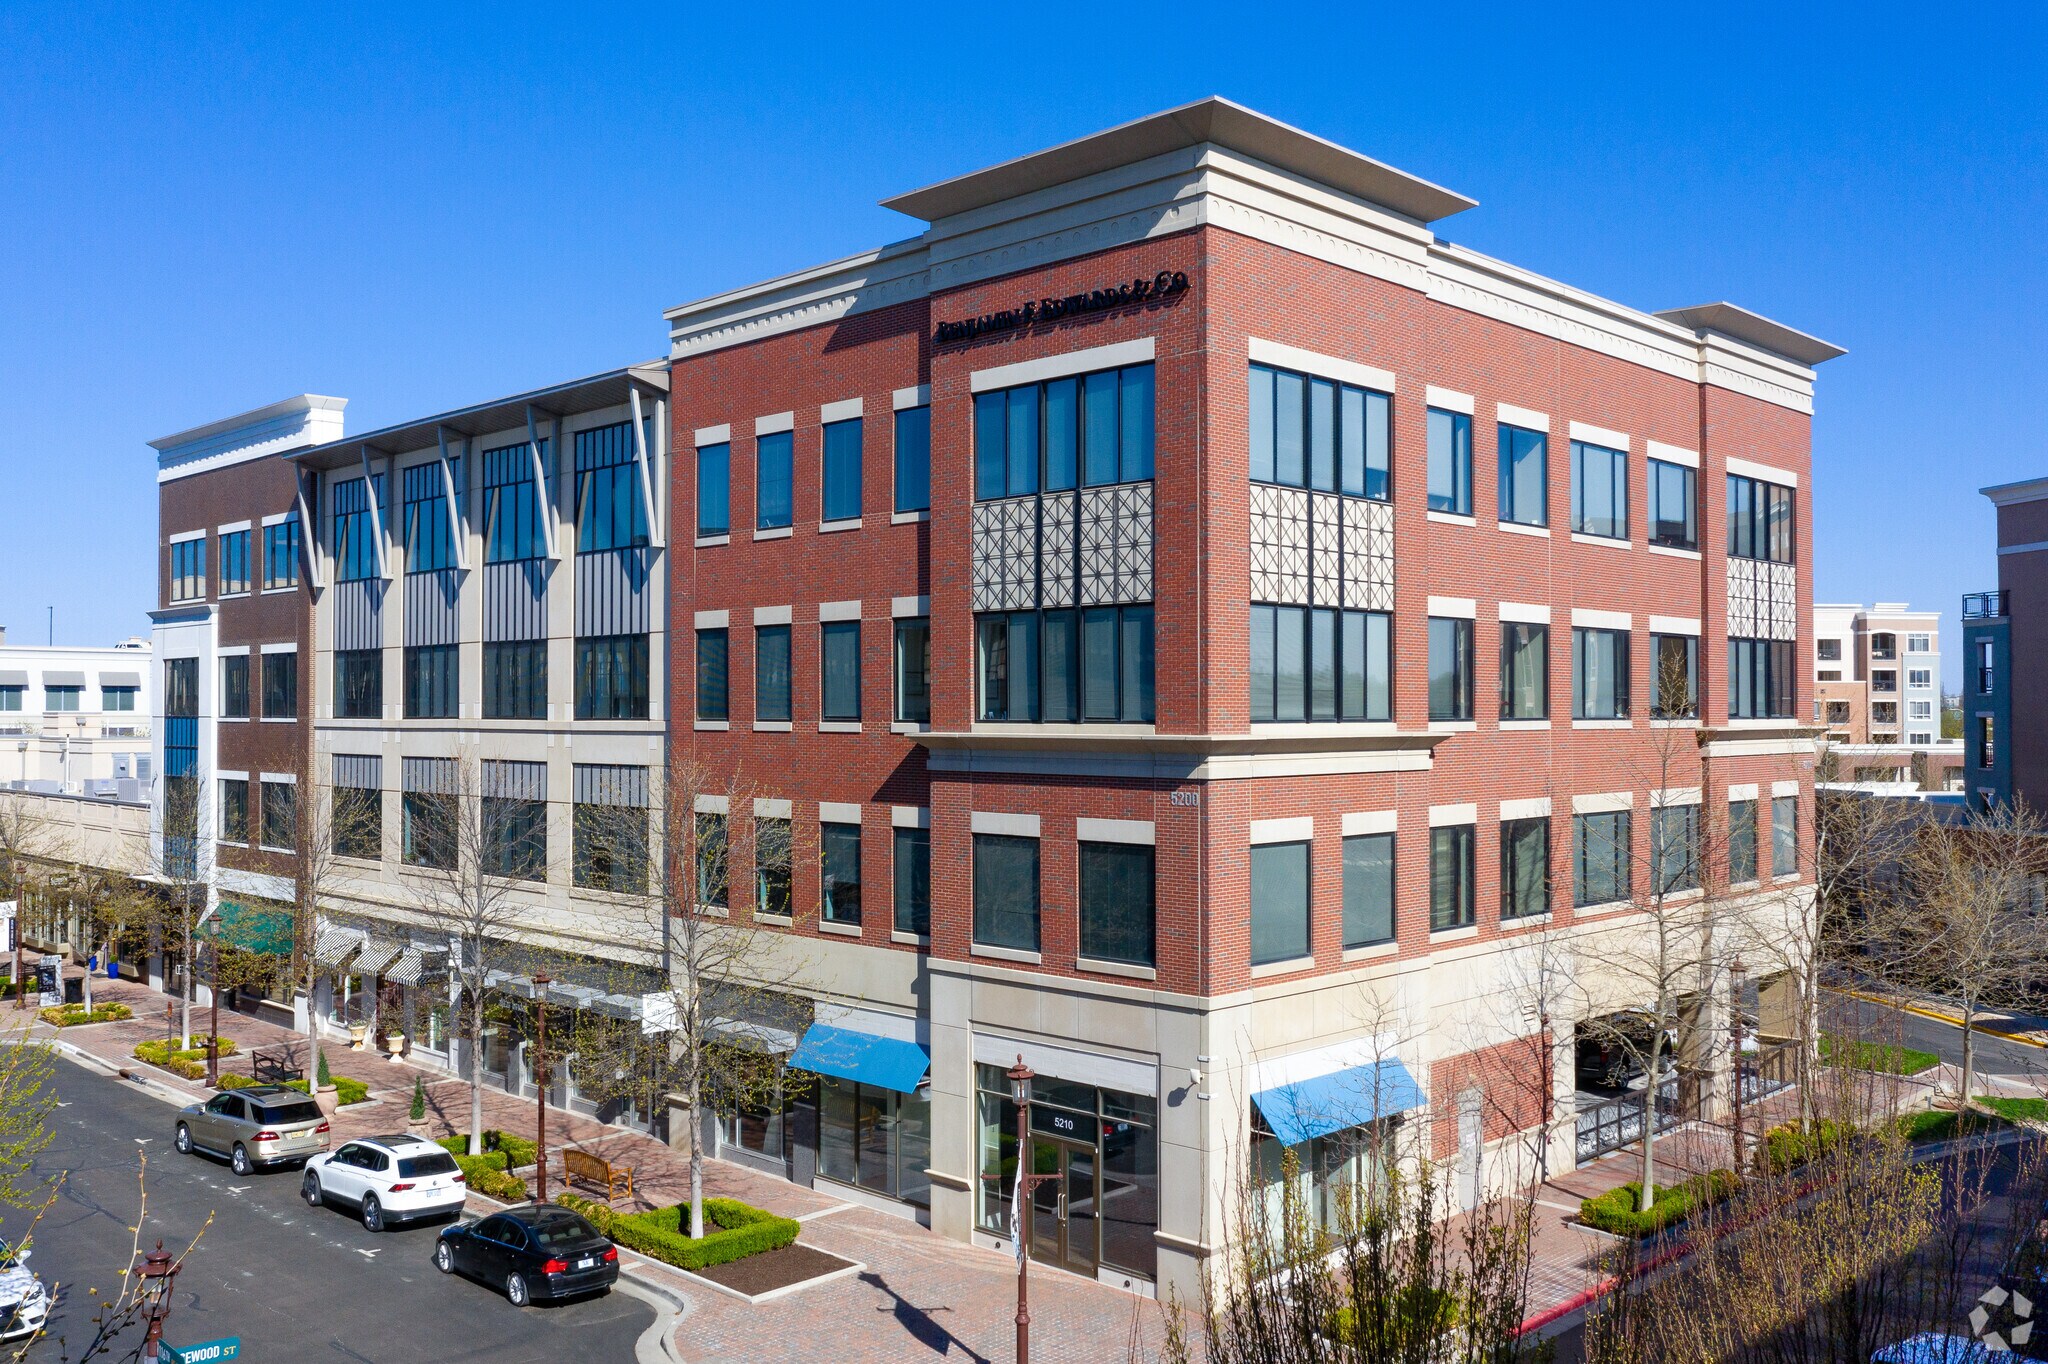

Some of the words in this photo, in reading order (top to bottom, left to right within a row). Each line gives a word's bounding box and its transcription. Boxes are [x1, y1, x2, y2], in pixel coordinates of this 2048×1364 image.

[1170, 792, 1199, 806] 5200
[1054, 1117, 1073, 1130] 5210
[223, 1345, 236, 1356] ST
